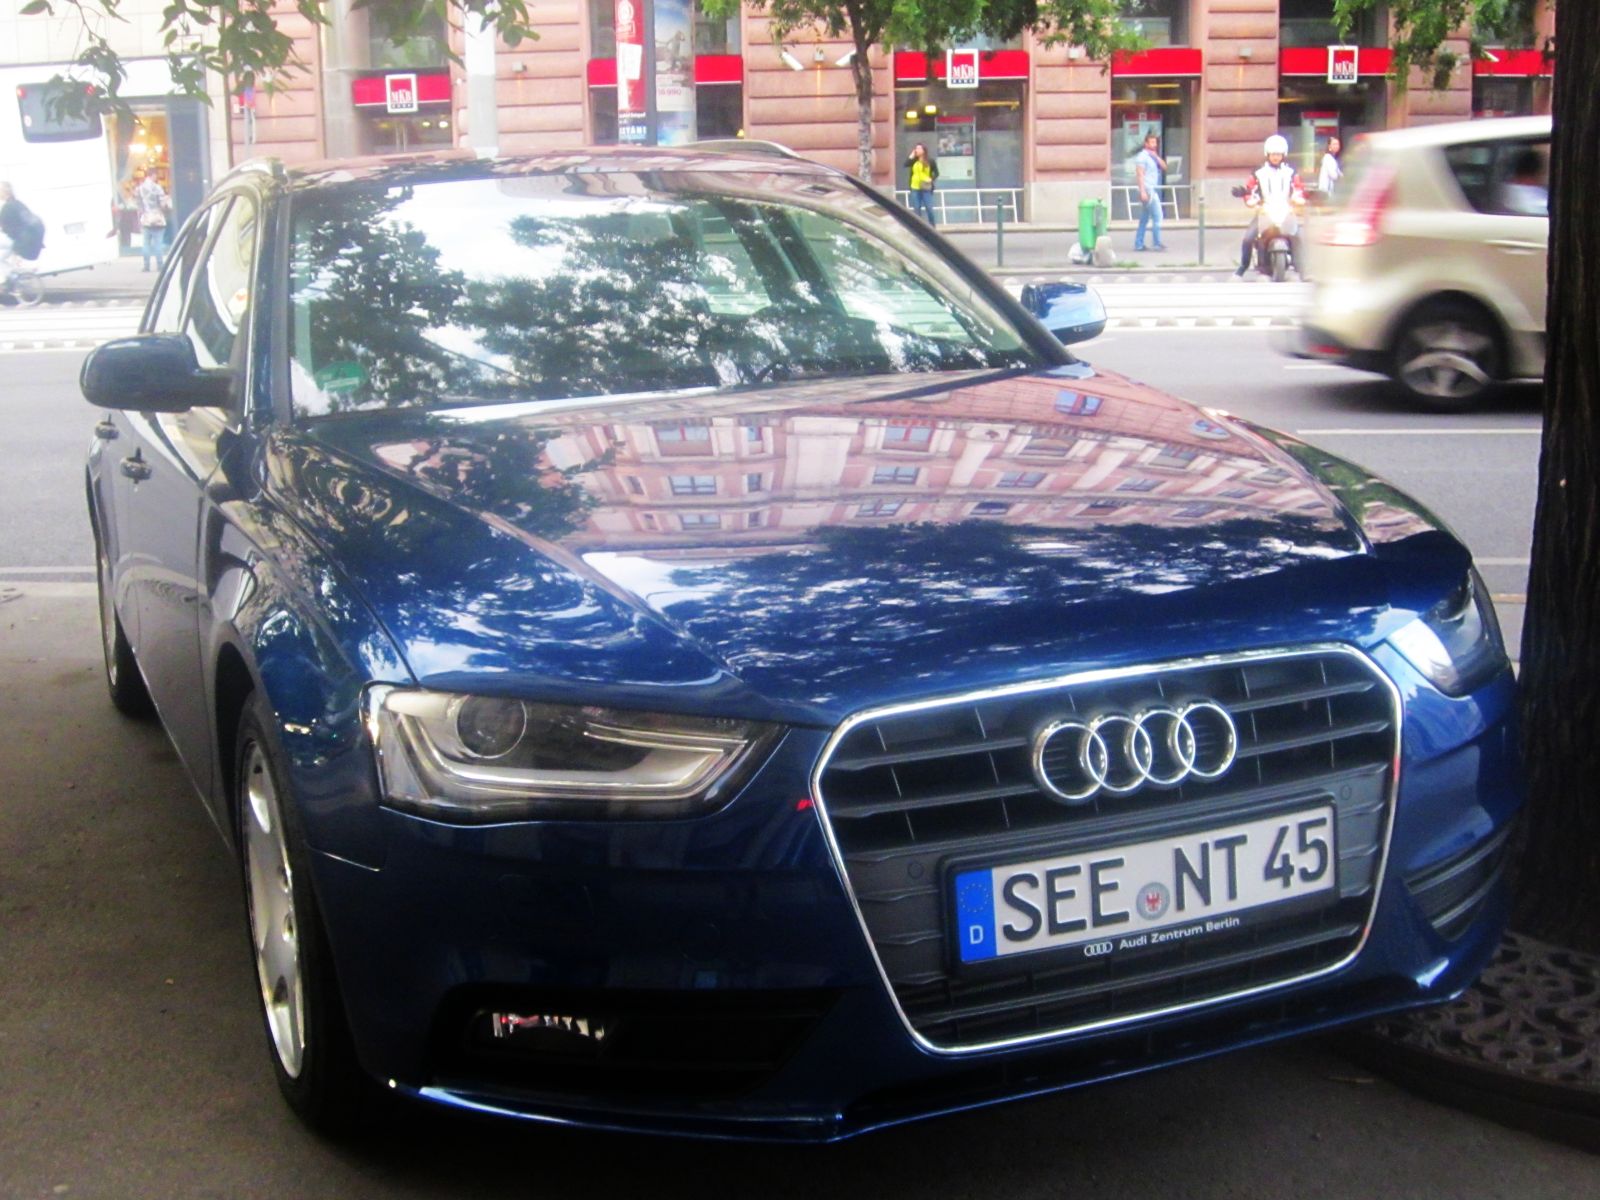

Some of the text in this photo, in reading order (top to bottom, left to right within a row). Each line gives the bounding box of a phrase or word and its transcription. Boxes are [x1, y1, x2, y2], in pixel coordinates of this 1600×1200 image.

[953, 64, 974, 79] MKB
[1335, 61, 1354, 75] MKB
[391, 89, 411, 104] MKB
[1002, 817, 1329, 942] SEE NT 45
[969, 925, 984, 945] D
[1119, 916, 1240, 950] Audi Zentrum Berlin
